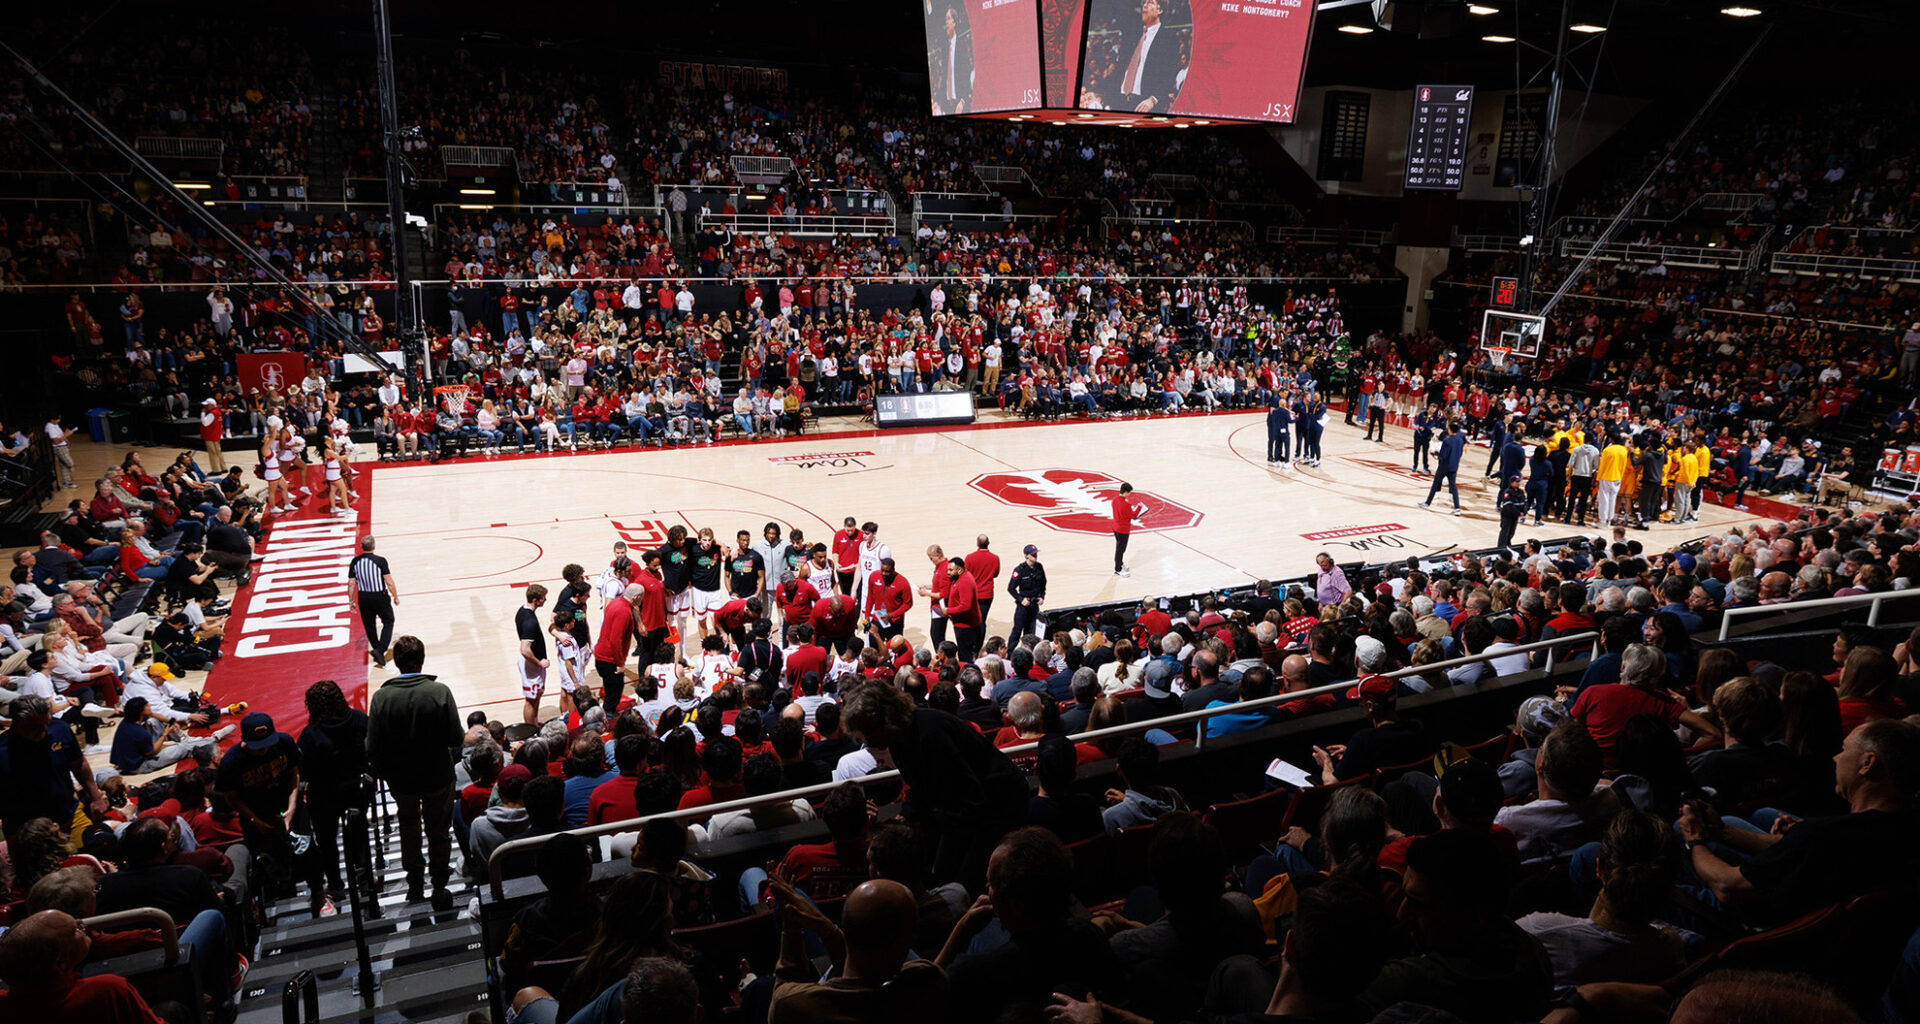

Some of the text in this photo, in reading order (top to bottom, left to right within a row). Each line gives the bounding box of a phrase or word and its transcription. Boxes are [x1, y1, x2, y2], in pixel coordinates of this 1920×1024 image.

[1221, 3, 1290, 18] MIKE MONTGOMERY?
[657, 60, 789, 90] STANFORD
[1021, 88, 1040, 104] JSX
[1262, 103, 1292, 118] JSX
[1783, 224, 1793, 235] 2
[1496, 288, 1513, 304] 20
[881, 400, 894, 410] 18
[1309, 524, 1399, 539] VANDERVEER
[864, 560, 873, 572] 42
[234, 511, 360, 658] CARDINAL
[714, 663, 723, 678] 4
[657, 674, 667, 688] 5
